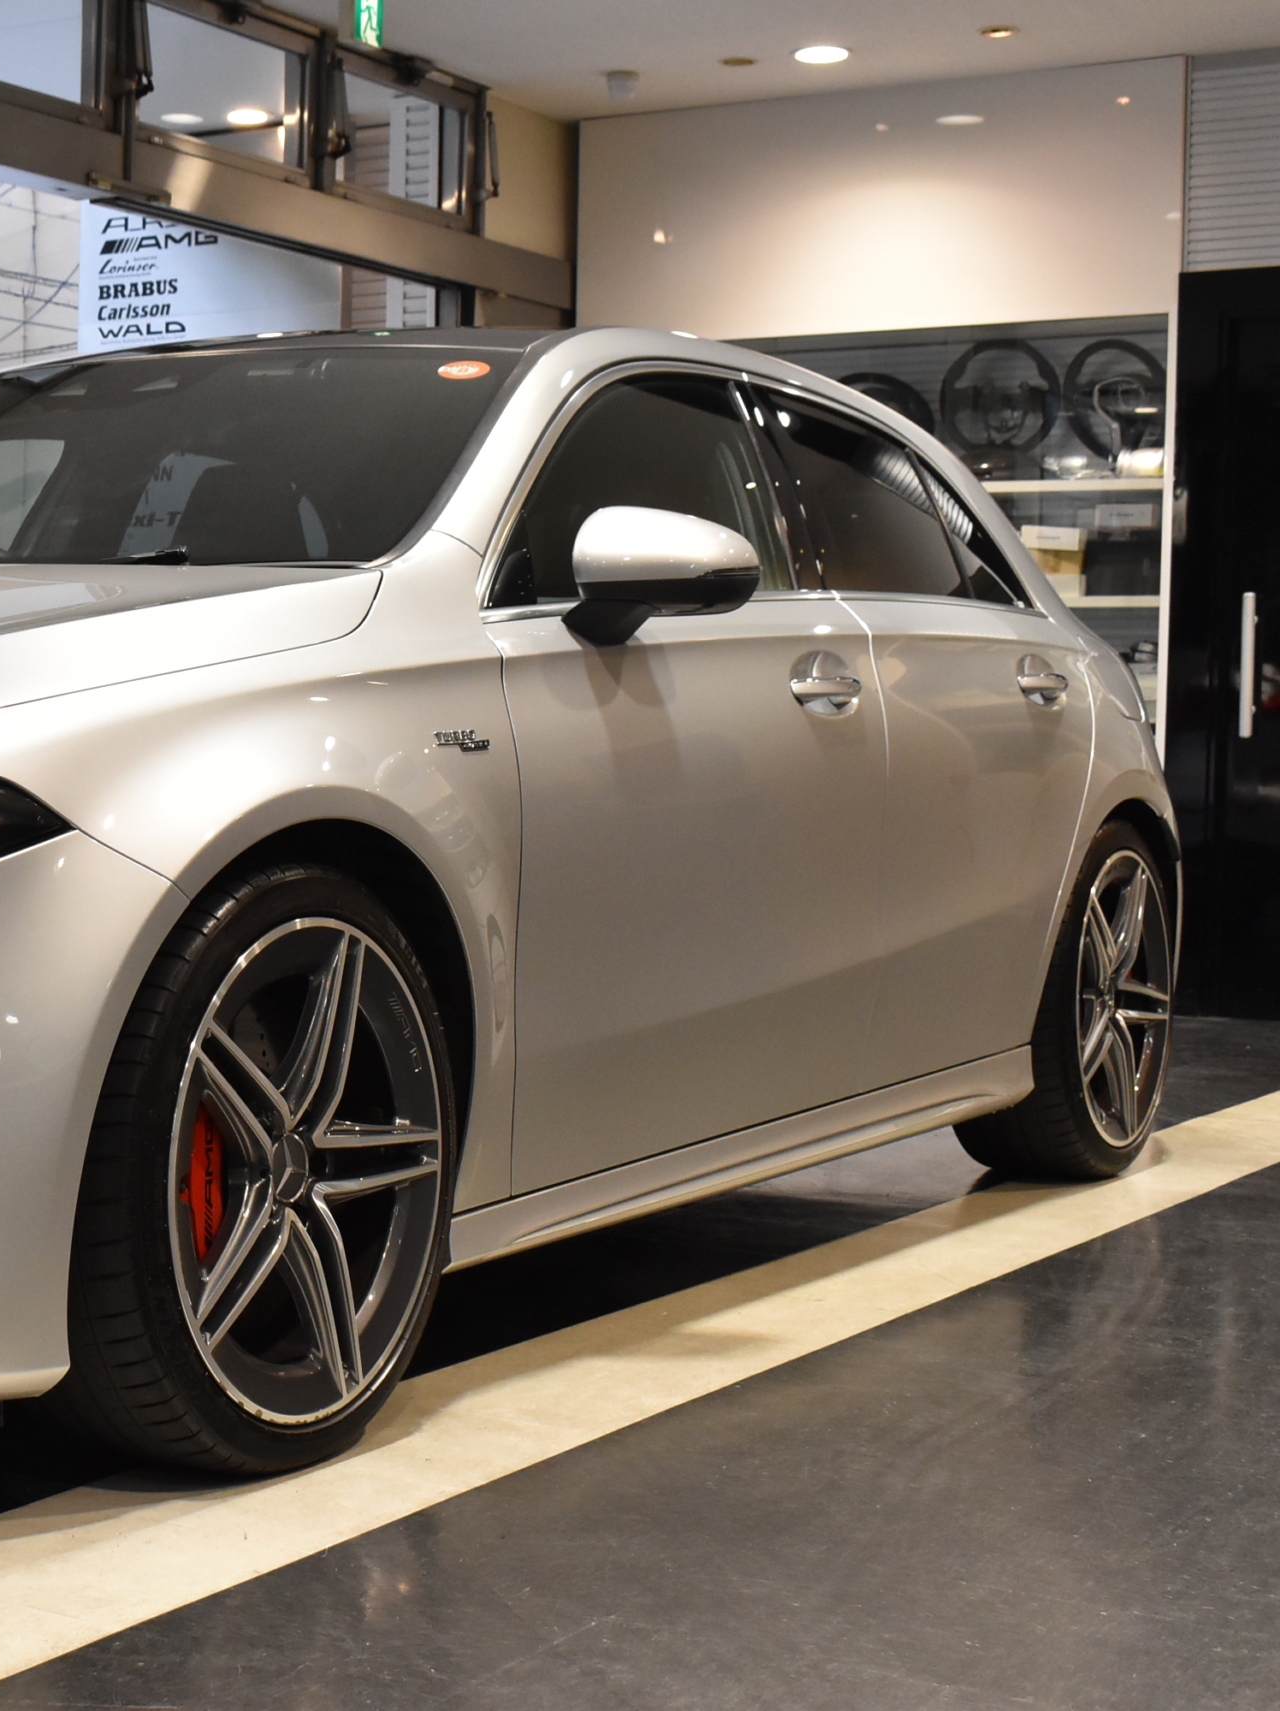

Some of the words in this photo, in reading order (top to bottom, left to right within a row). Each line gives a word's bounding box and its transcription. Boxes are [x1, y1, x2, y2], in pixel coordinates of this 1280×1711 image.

[135, 230, 219, 252] AMG
[99, 258, 156, 275] Lorinser
[98, 279, 178, 300] BRABUS
[98, 303, 171, 321] Carlsson
[98, 321, 186, 339] WALD
